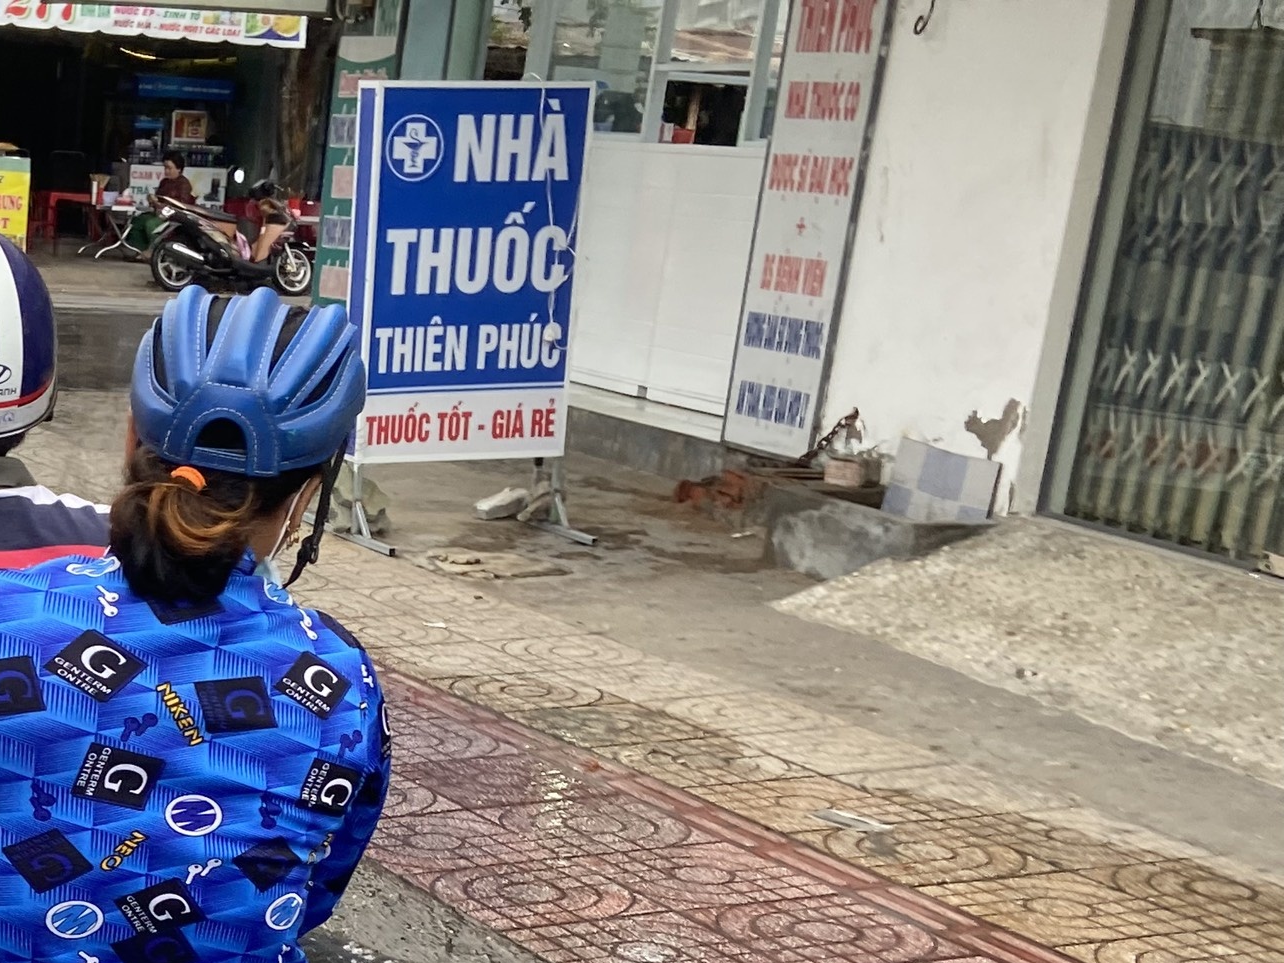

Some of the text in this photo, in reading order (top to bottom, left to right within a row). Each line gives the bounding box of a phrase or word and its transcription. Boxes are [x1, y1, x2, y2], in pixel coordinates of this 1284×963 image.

[453, 98, 569, 183] NHÀ
[386, 201, 568, 296] THUỐC
[375, 312, 562, 374] THIÊN PHÚC
[366, 402, 431, 446] THUỐC
[437, 401, 473, 442] TỐT
[491, 402, 524, 440] GIÁ
[530, 398, 557, 438] RẺ
[54, 656, 112, 695] GENTERM
[80, 645, 127, 679] G
[57, 668, 99, 696] ONTRE
[282, 677, 331, 713] GENTERM
[303, 665, 339, 698] G
[156, 682, 204, 746] NIKEN
[285, 688, 320, 713] ONTRE
[76, 752, 98, 788] ONTRE
[85, 747, 112, 797] GENTERM
[104, 763, 148, 795] G
[320, 778, 353, 807] G
[121, 904, 147, 933] ONTRE
[126, 895, 158, 934] GENTERM
[148, 893, 191, 922] G
